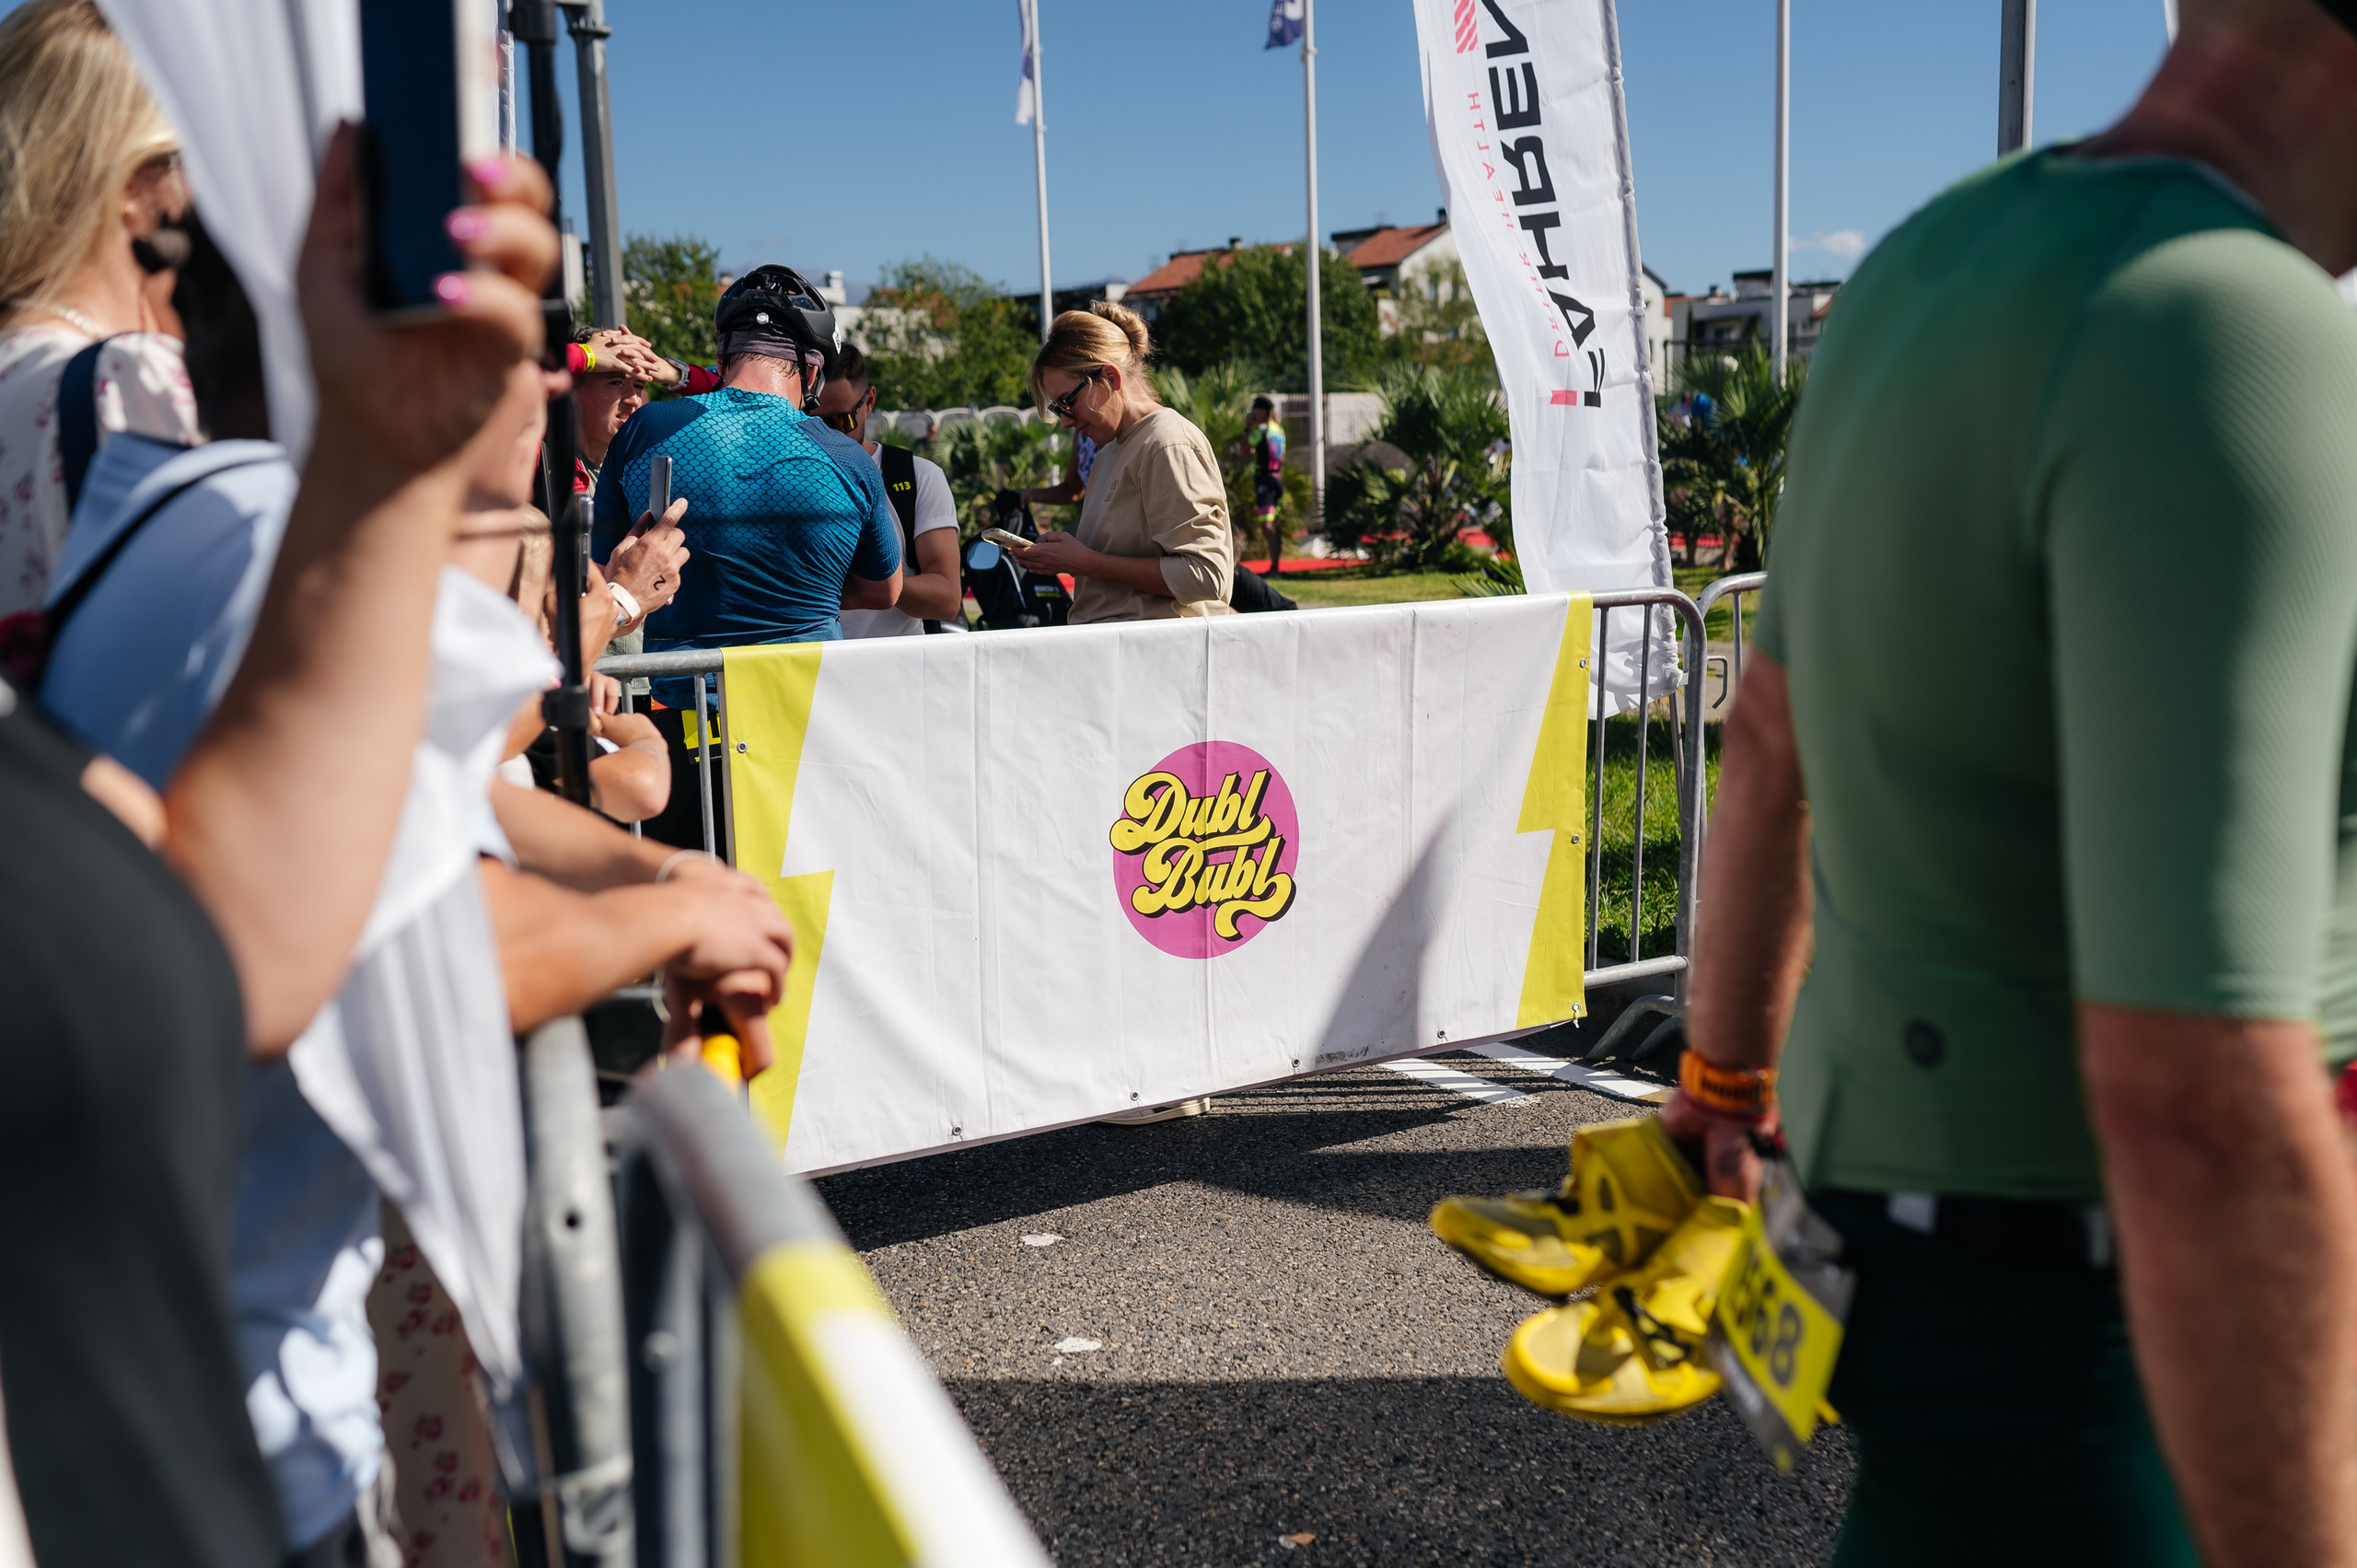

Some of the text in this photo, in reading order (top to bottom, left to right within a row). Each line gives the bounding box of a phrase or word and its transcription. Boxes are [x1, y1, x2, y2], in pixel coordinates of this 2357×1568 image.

[892, 481, 911, 492] 113
[1109, 768, 1272, 855] Dubl
[1132, 832, 1296, 942] Bubl
